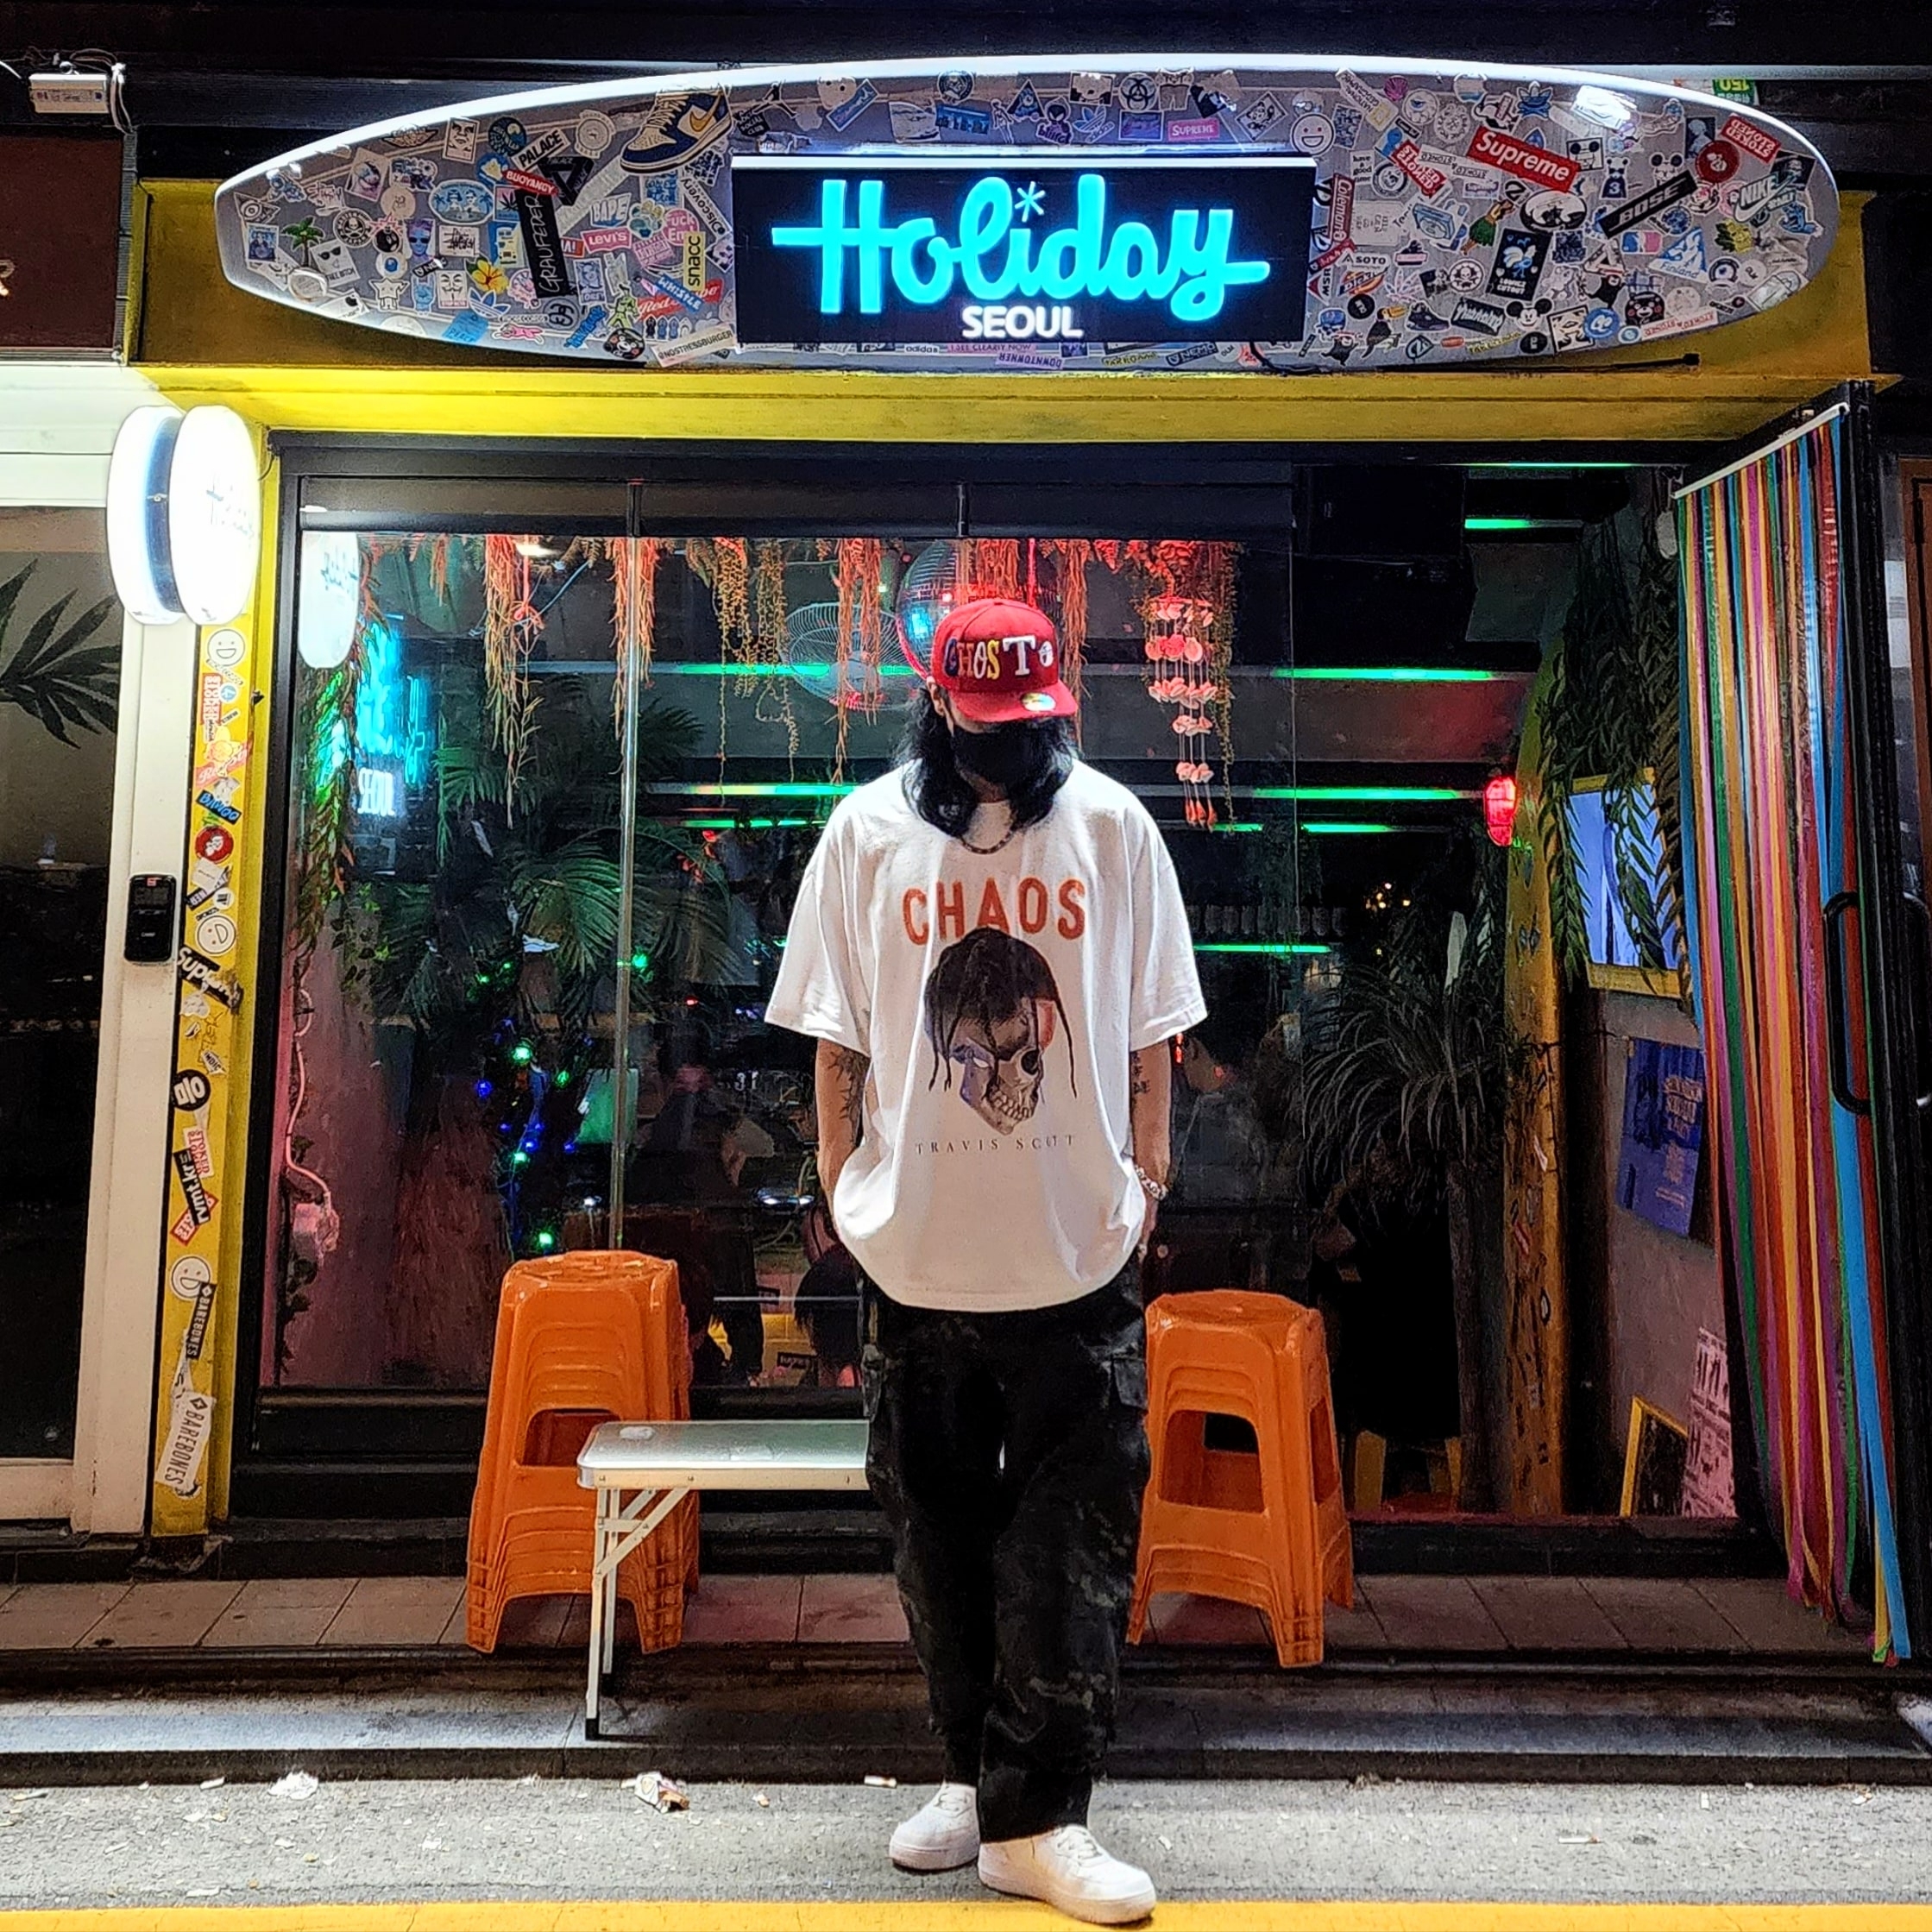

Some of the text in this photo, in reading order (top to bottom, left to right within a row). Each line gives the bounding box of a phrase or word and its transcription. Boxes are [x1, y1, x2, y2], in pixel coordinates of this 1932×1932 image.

[519, 129, 563, 167] PALACE
[1476, 131, 1570, 181] Supreme
[506, 170, 556, 194] BUOYANCY
[1353, 166, 1372, 175] good
[1608, 182, 1620, 194] 3
[1618, 183, 1683, 226] BOSE
[1740, 173, 1778, 208] NIKE
[592, 199, 629, 221] BAPE
[1333, 179, 1353, 242] Coleman
[524, 192, 563, 293] GRAUFEDER
[771, 173, 1270, 323] Holiday
[1356, 255, 1387, 265] SOTO
[688, 235, 701, 286] snacc
[1660, 260, 1700, 280] Finland
[658, 275, 702, 310] WHISTLE
[1322, 267, 1332, 296] MSR
[961, 305, 1085, 339] SEOUL
[905, 344, 940, 353] adidas
[998, 352, 1063, 368] DOWNTOWNER
[902, 876, 1086, 947] CHAOS
[915, 1137, 1000, 1155] TRAVIS
[187, 1295, 210, 1356] BAREBONES
[163, 1409, 205, 1485] BAREBONES
